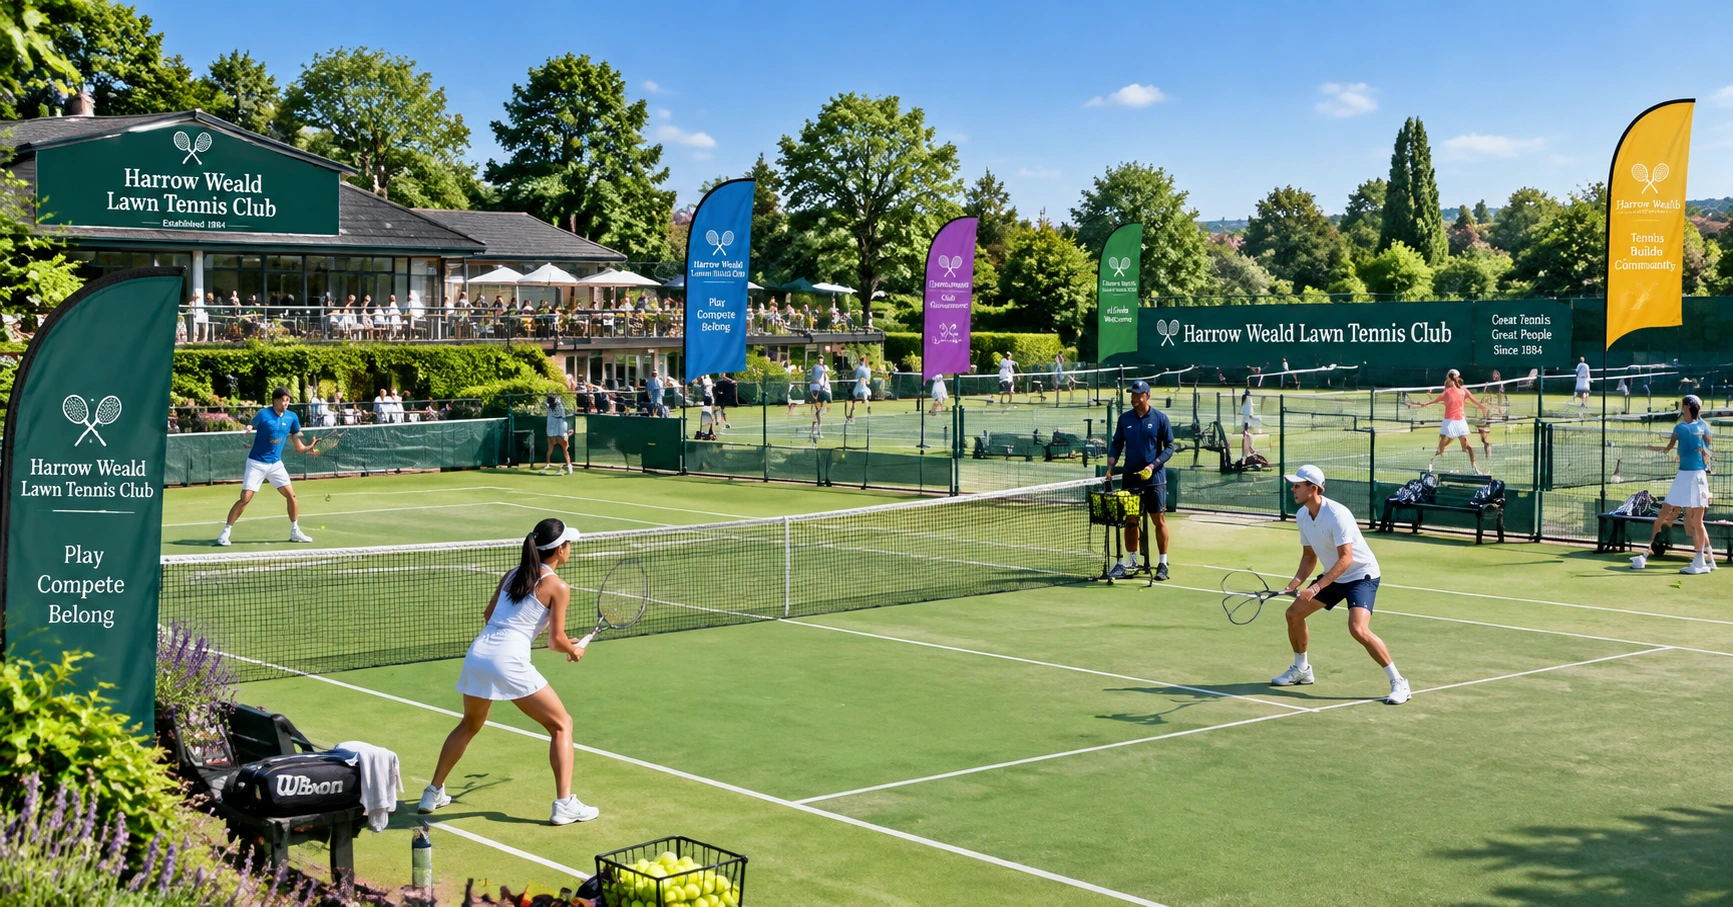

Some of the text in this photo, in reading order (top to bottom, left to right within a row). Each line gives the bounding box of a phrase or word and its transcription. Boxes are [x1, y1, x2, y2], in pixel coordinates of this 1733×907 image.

[124, 167, 263, 194] Harrow Weald
[106, 191, 277, 218] Lawn Tennis Club
[1183, 320, 1452, 343] Harrow Weald Lawn Tennis Club
[1491, 327, 1553, 342] Great People
[1493, 344, 1519, 356] Since
[30, 458, 147, 477] Harrow Weald
[20, 480, 154, 498] Lawn Tennis Club
[64, 544, 105, 570] Play
[37, 574, 125, 600] Compete
[48, 604, 115, 629] Belong
